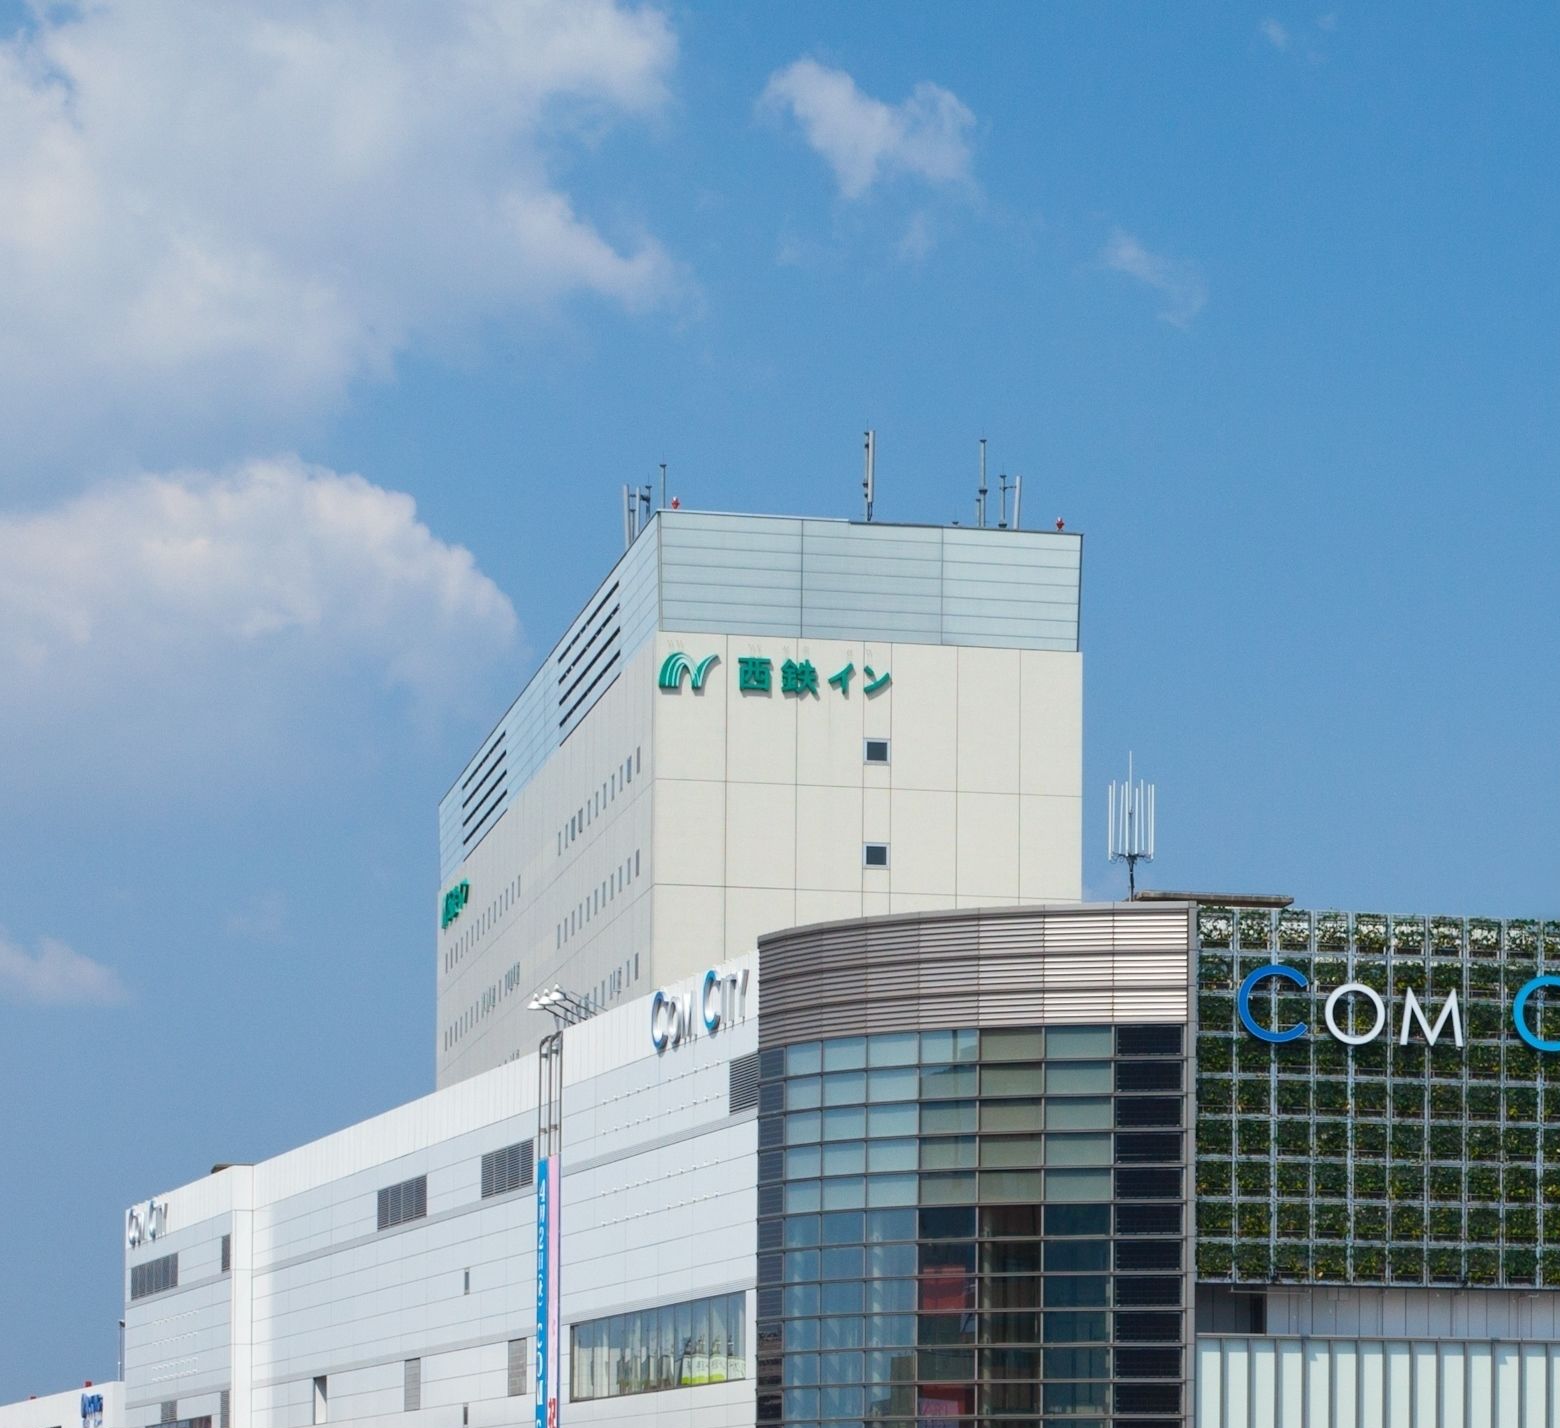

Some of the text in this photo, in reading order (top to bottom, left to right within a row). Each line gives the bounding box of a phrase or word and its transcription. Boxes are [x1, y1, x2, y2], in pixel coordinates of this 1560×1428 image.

[738, 657, 892, 695] 西鉄イン
[1238, 965, 1464, 1047] COM
